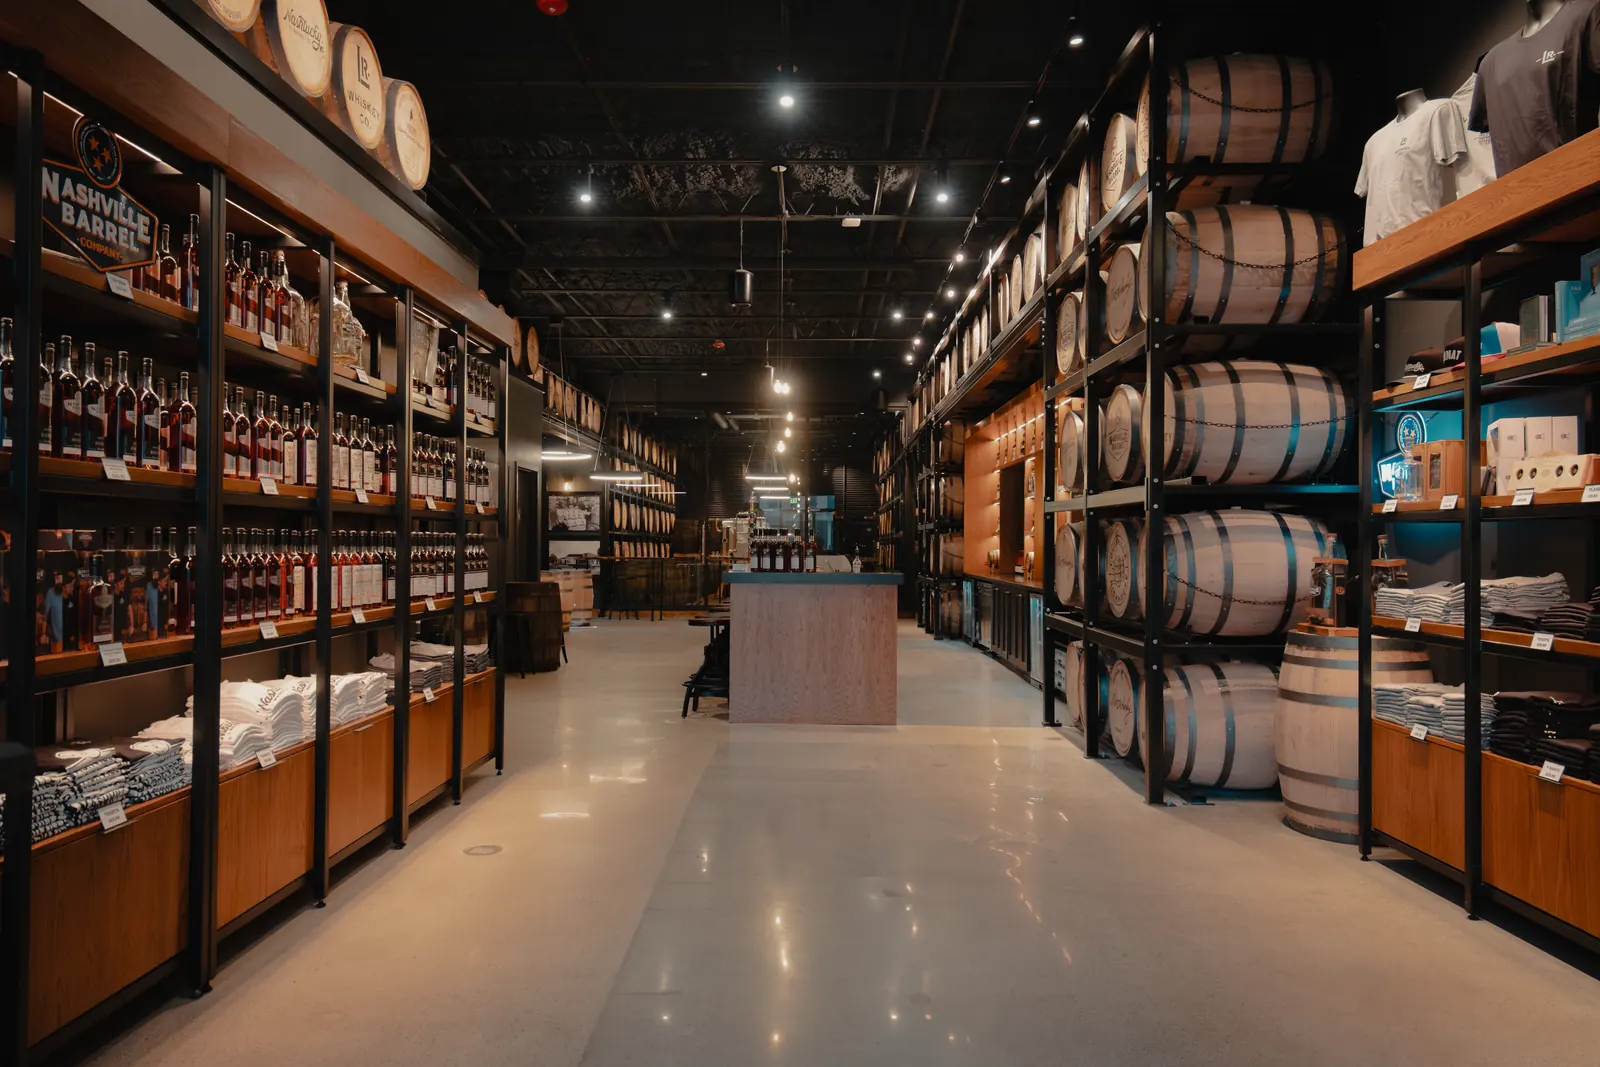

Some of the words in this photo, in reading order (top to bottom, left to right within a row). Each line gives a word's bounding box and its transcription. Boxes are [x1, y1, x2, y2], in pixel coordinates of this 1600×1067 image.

[347, 89, 380, 121] WHISKEY
[41, 166, 150, 245] NASHVILLE
[62, 200, 139, 255] BARREL
[79, 237, 121, 260] COMPANY
